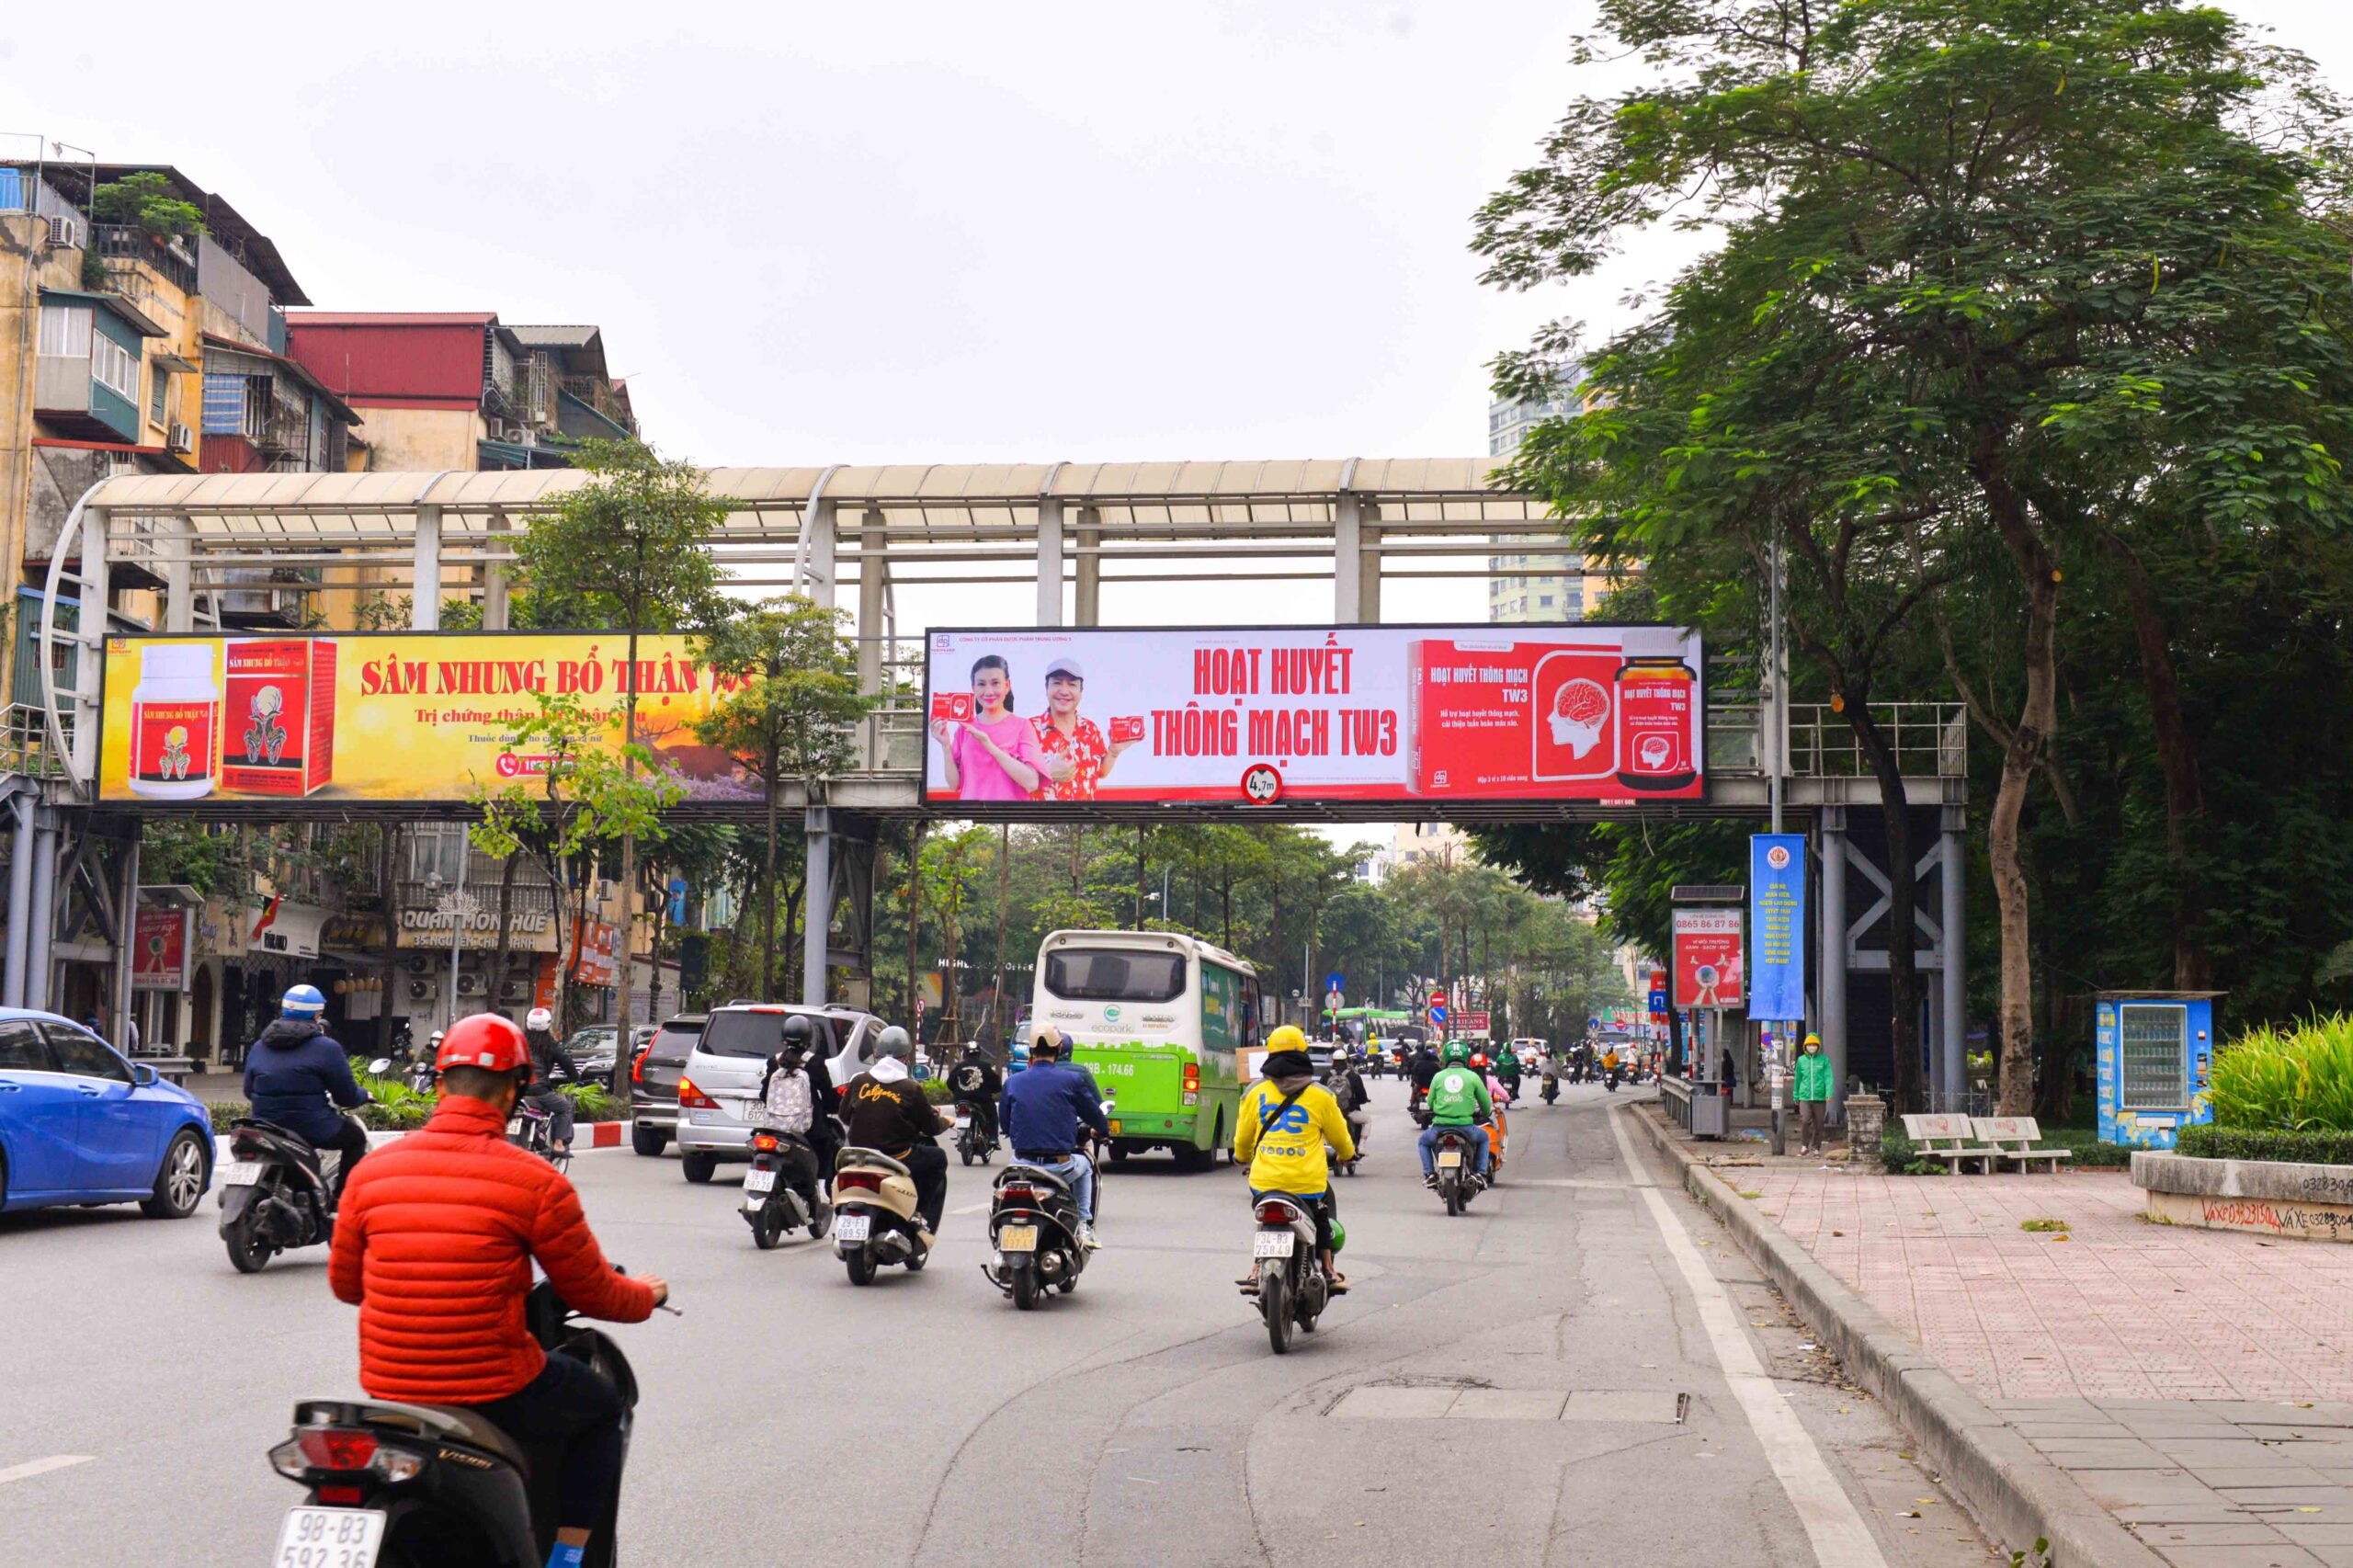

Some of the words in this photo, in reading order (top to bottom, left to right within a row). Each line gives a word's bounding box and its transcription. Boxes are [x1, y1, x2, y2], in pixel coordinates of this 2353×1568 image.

[361, 653, 430, 697] SÂM
[436, 659, 548, 696] NHUNG
[555, 644, 604, 694] BỔ
[612, 652, 699, 706] THẬN
[1194, 648, 1262, 706] HOẠT
[1271, 632, 1354, 694] HUYẾT
[1430, 667, 1451, 687] HOẠT
[1453, 663, 1477, 684] HUYẾT
[1479, 665, 1504, 684] THÔNG
[1506, 668, 1529, 687] MẠCH
[1502, 688, 1529, 703] TW3
[415, 709, 438, 726] Trị
[442, 707, 492, 725] chứng
[469, 733, 496, 743] Thuốc
[499, 733, 517, 743] dùn
[1151, 701, 1238, 756] THÔNG
[1248, 709, 1329, 767] MẠCH
[1338, 709, 1398, 756] TW3
[1677, 920, 1699, 928] 0865
[1700, 920, 1711, 928] 86
[1714, 920, 1725, 928] 87
[1728, 920, 1740, 928] 86
[1091, 1023, 1132, 1034] ecopark
[1108, 1063, 1134, 1075] 174.66
[750, 1102, 763, 1111] 30
[1444, 1095, 1464, 1103] Grab
[747, 1110, 765, 1120] 617
[1259, 1093, 1310, 1134] be
[296, 1513, 368, 1544] 98-B3
